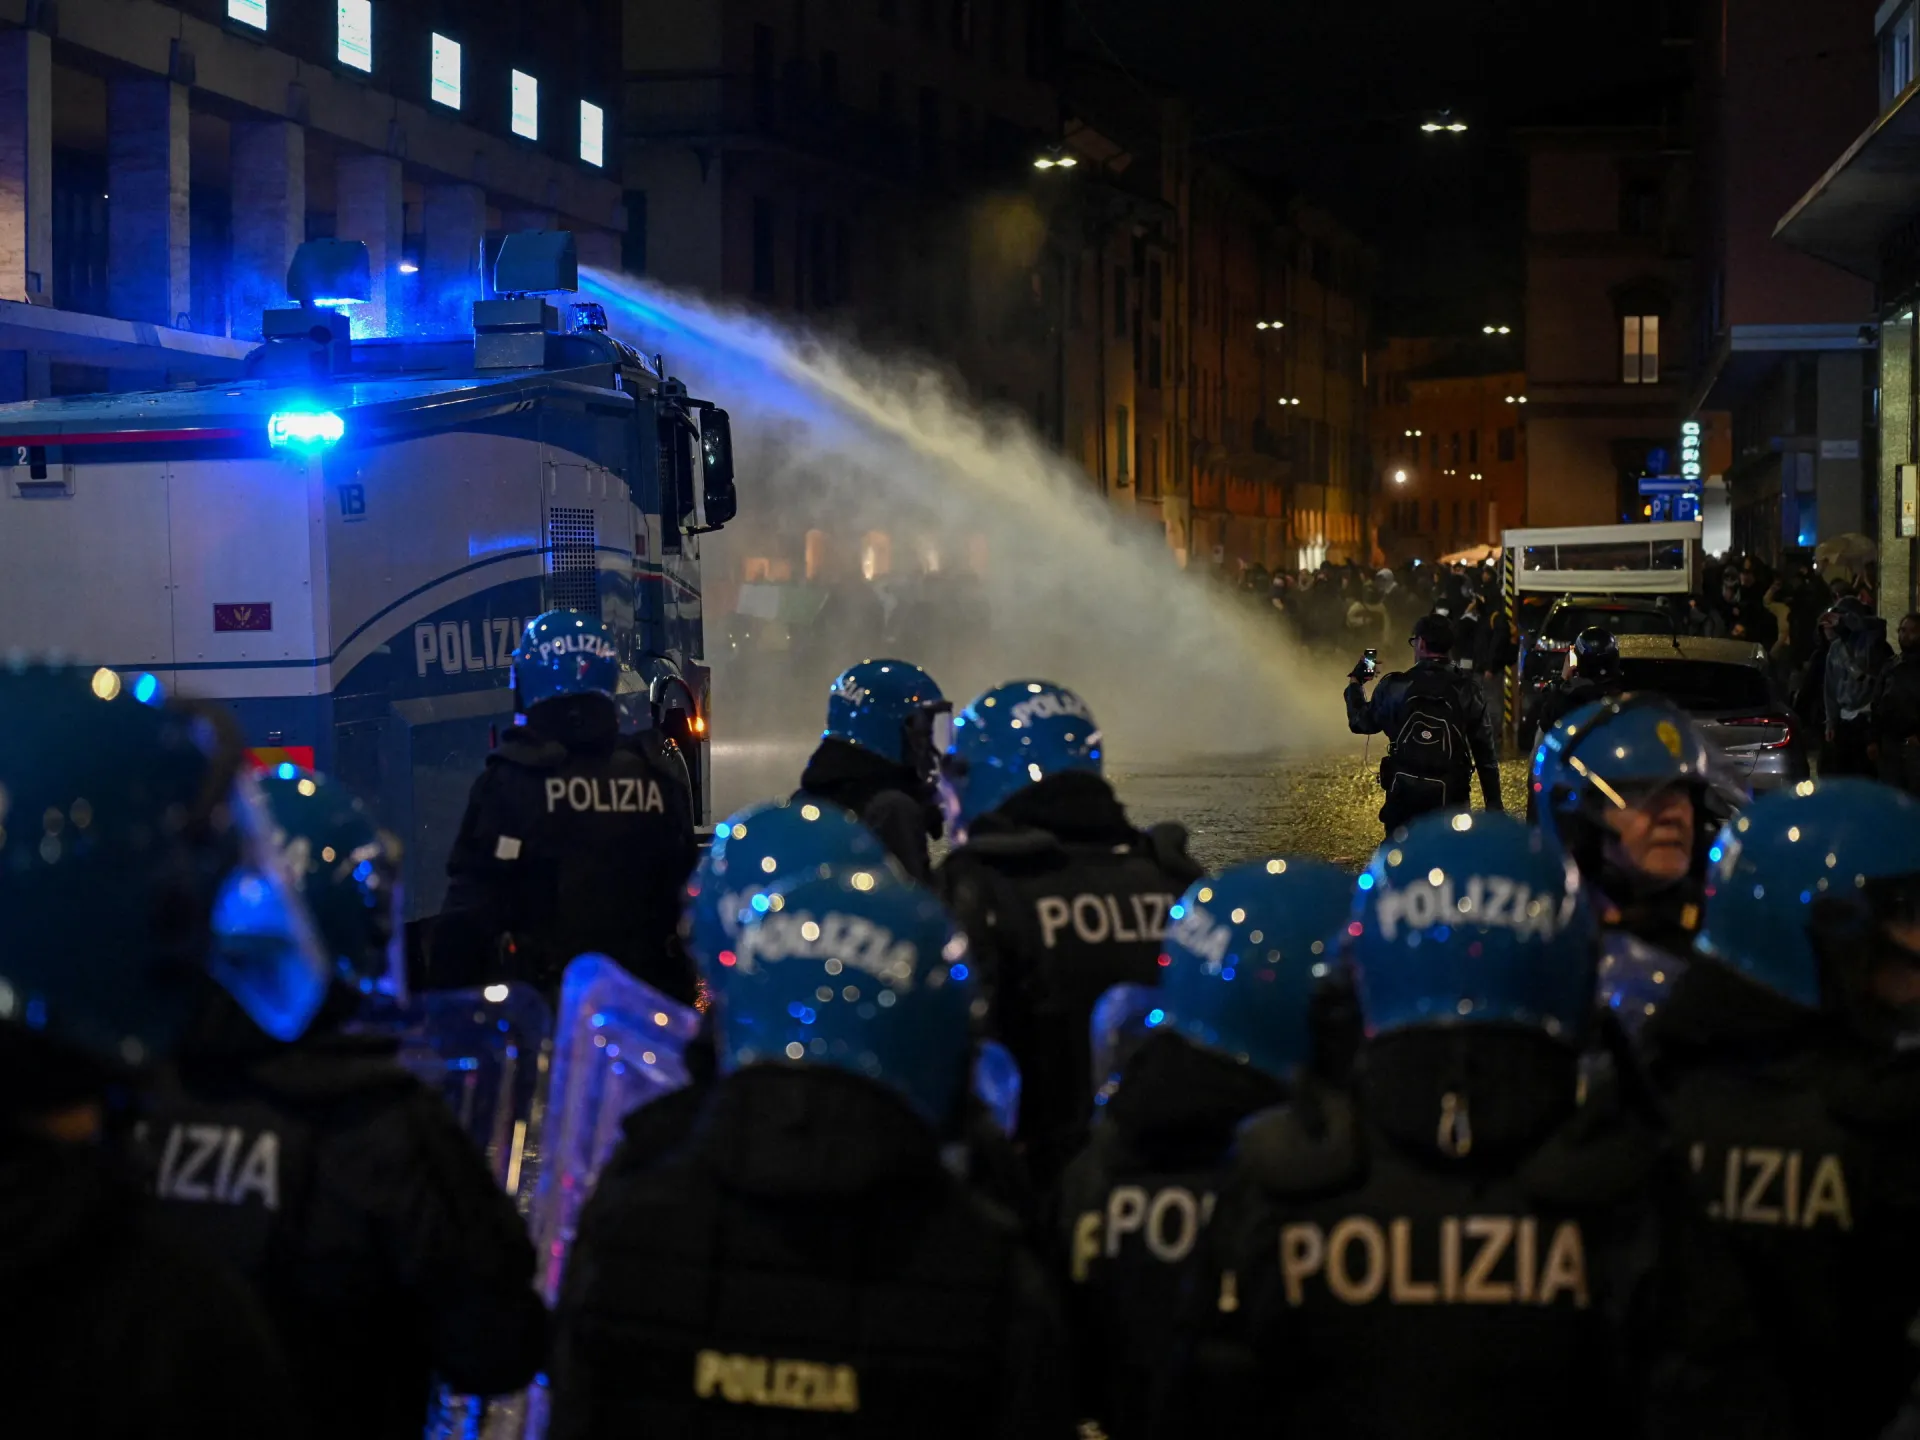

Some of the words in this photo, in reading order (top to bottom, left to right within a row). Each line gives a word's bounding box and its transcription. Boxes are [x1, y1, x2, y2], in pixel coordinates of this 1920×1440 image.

[17, 446, 28, 465] 2
[1678, 499, 1691, 519] P
[414, 616, 536, 677] POLIZI
[545, 777, 664, 814] POLIZIA
[1377, 872, 1556, 944] POLIZIA
[1279, 1213, 1592, 1310] POLIZIA
[692, 1347, 863, 1415] POLIZIA
